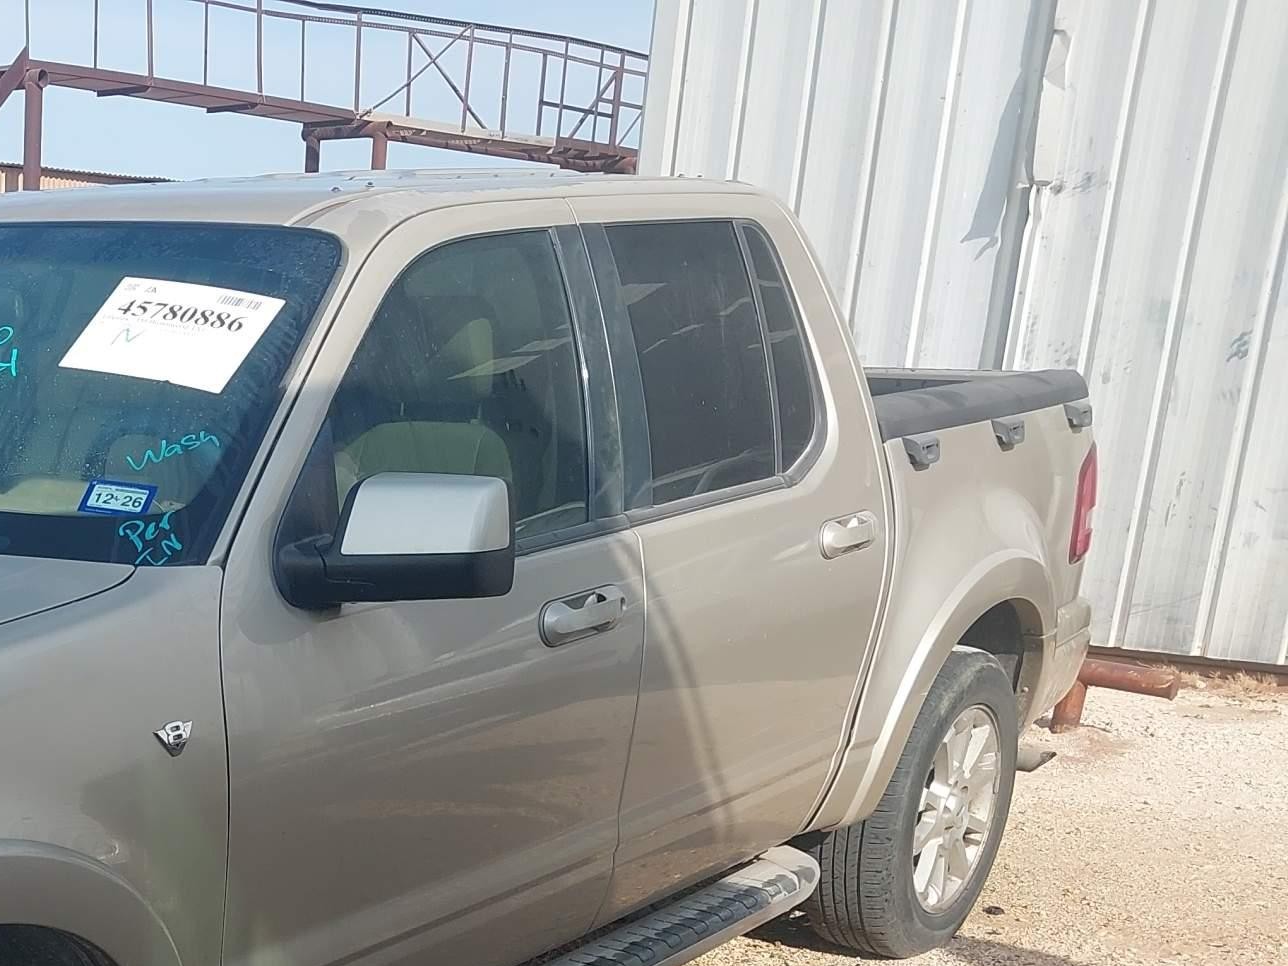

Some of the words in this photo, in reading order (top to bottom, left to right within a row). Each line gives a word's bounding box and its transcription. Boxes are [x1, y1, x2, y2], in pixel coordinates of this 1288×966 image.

[118, 299, 248, 333] 45780886
[94, 492, 114, 505] 12
[120, 495, 144, 508] 26
